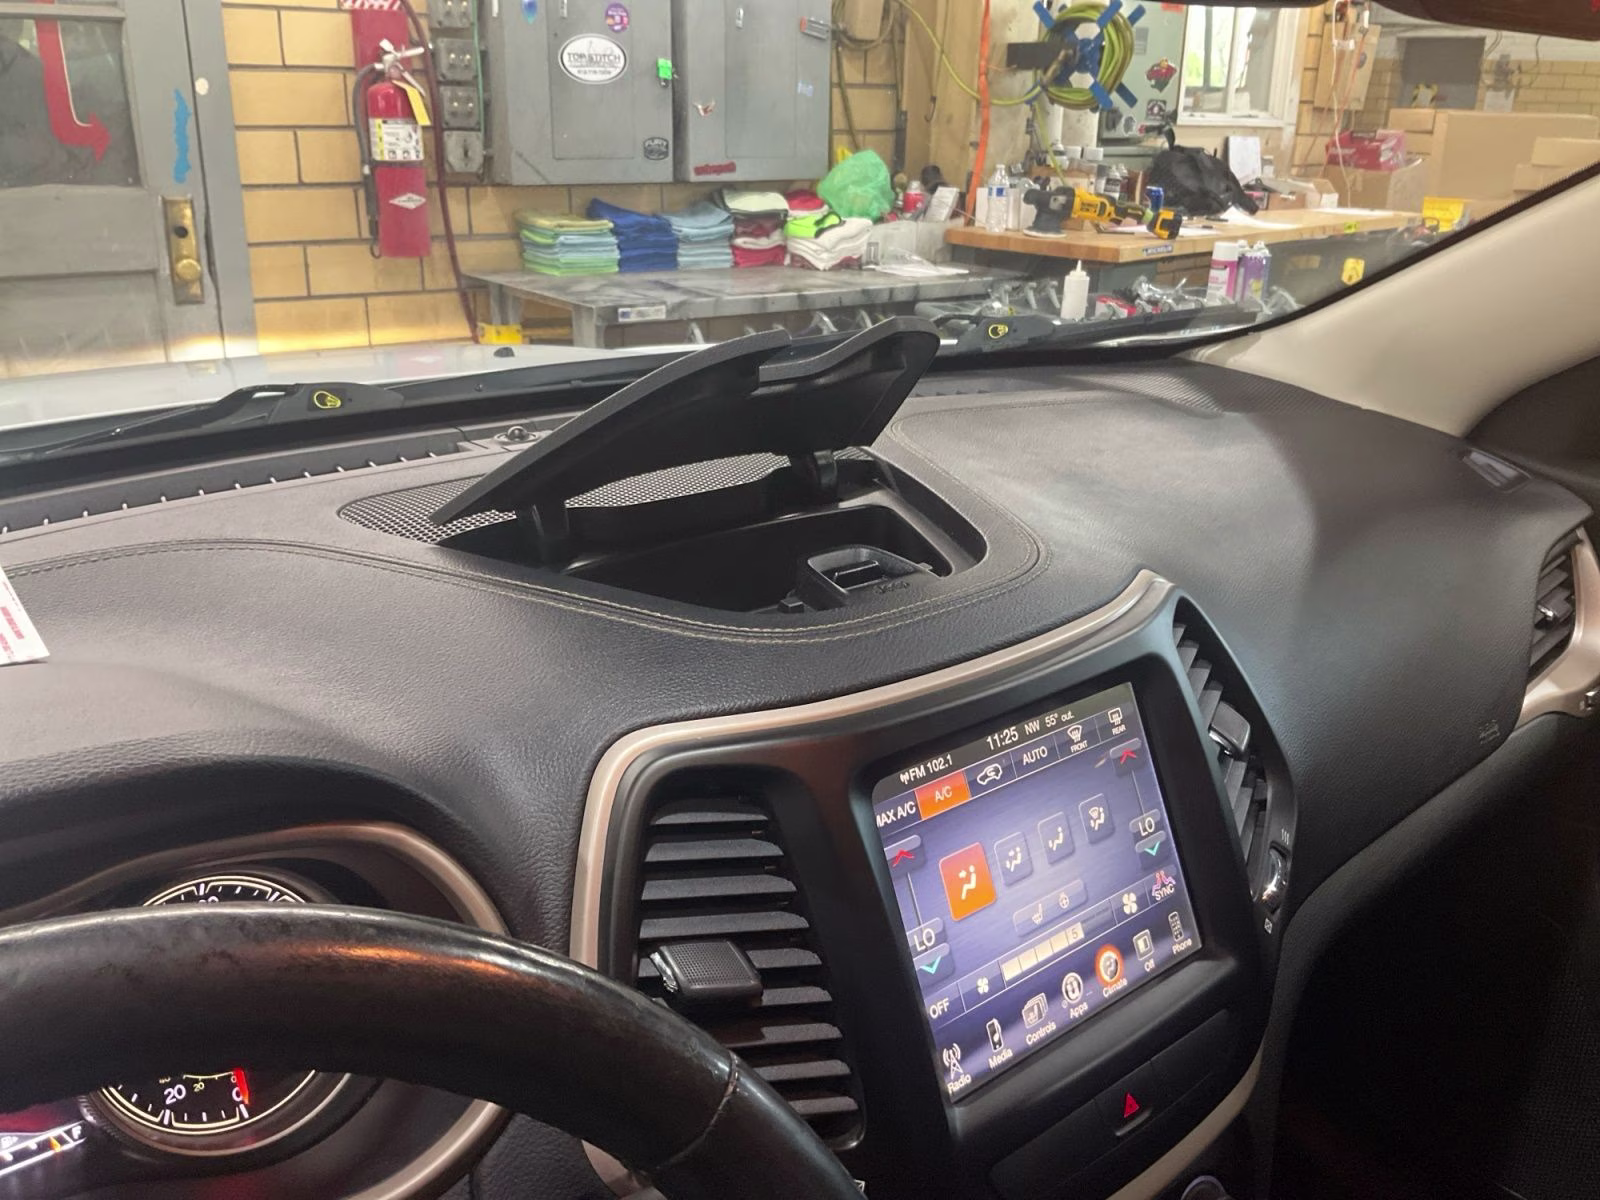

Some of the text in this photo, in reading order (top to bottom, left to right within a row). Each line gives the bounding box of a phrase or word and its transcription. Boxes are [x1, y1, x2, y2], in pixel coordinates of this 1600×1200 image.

[1024, 719, 1040, 736] NW
[1045, 712, 1058, 728] 55°
[986, 726, 1019, 750] 11:25
[1111, 724, 1127, 735] REAR
[1070, 740, 1088, 753] FRONT
[1023, 746, 1048, 766] AUTO
[909, 754, 953, 781] FM 102.1
[934, 785, 952, 803] A/C
[897, 801, 916, 820] A/C
[1138, 817, 1155, 837] LO
[1154, 883, 1175, 901] SYNC
[914, 928, 936, 951] LO
[1071, 928, 1079, 940] 5
[1172, 938, 1192, 954] Phone
[1144, 958, 1156, 972] Off
[1102, 977, 1128, 998] Climate
[929, 997, 950, 1019] OFF
[1069, 1002, 1088, 1018] Apps
[1025, 1021, 1057, 1046] Controls
[988, 1048, 1014, 1070] Media
[193, 1082, 205, 1092] 20
[946, 1073, 972, 1095] Radio
[163, 1084, 187, 1105] 20
[72, 1125, 82, 1140] F
